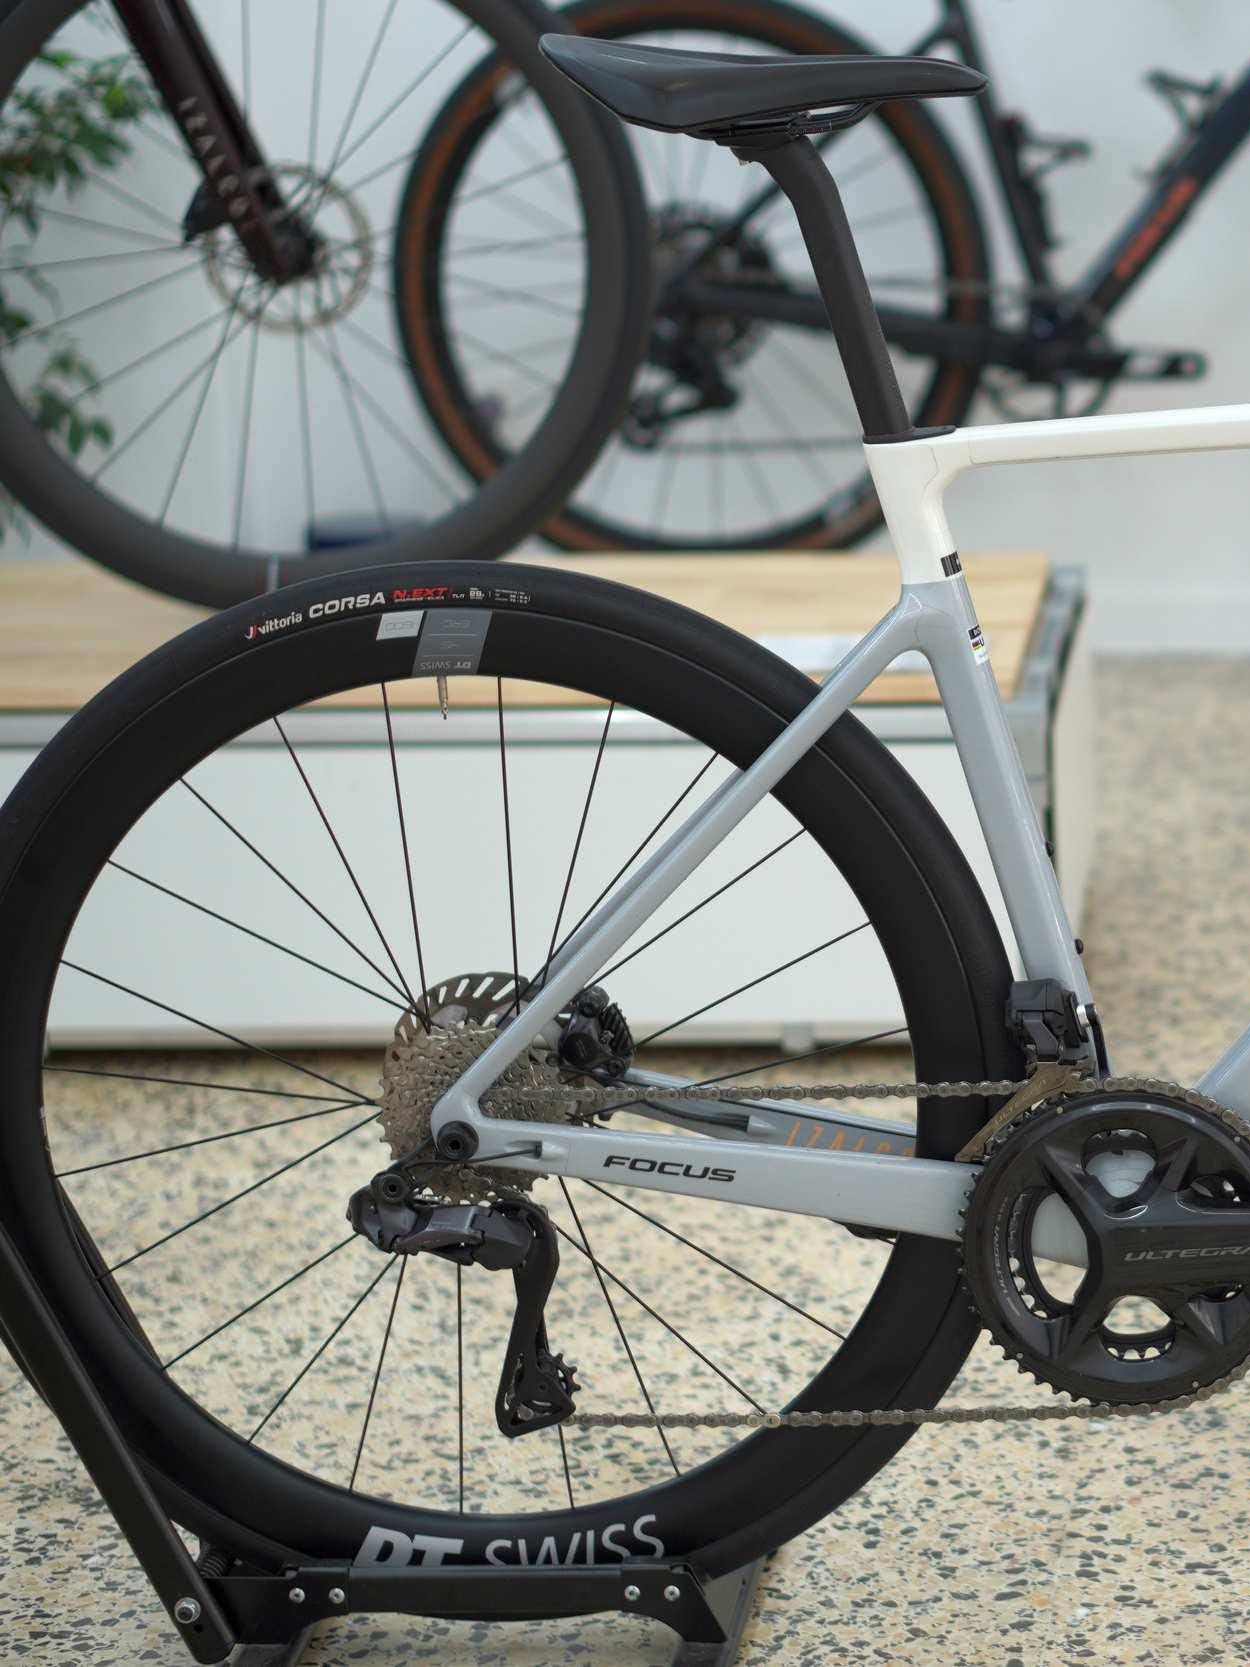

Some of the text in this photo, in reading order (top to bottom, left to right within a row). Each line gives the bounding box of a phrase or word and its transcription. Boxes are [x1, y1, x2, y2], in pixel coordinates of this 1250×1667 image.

[257, 611, 303, 636] vittoria
[308, 591, 386, 619] CORSA
[603, 1155, 736, 1182] FOCUS
[353, 1513, 665, 1567] DT SWISS
